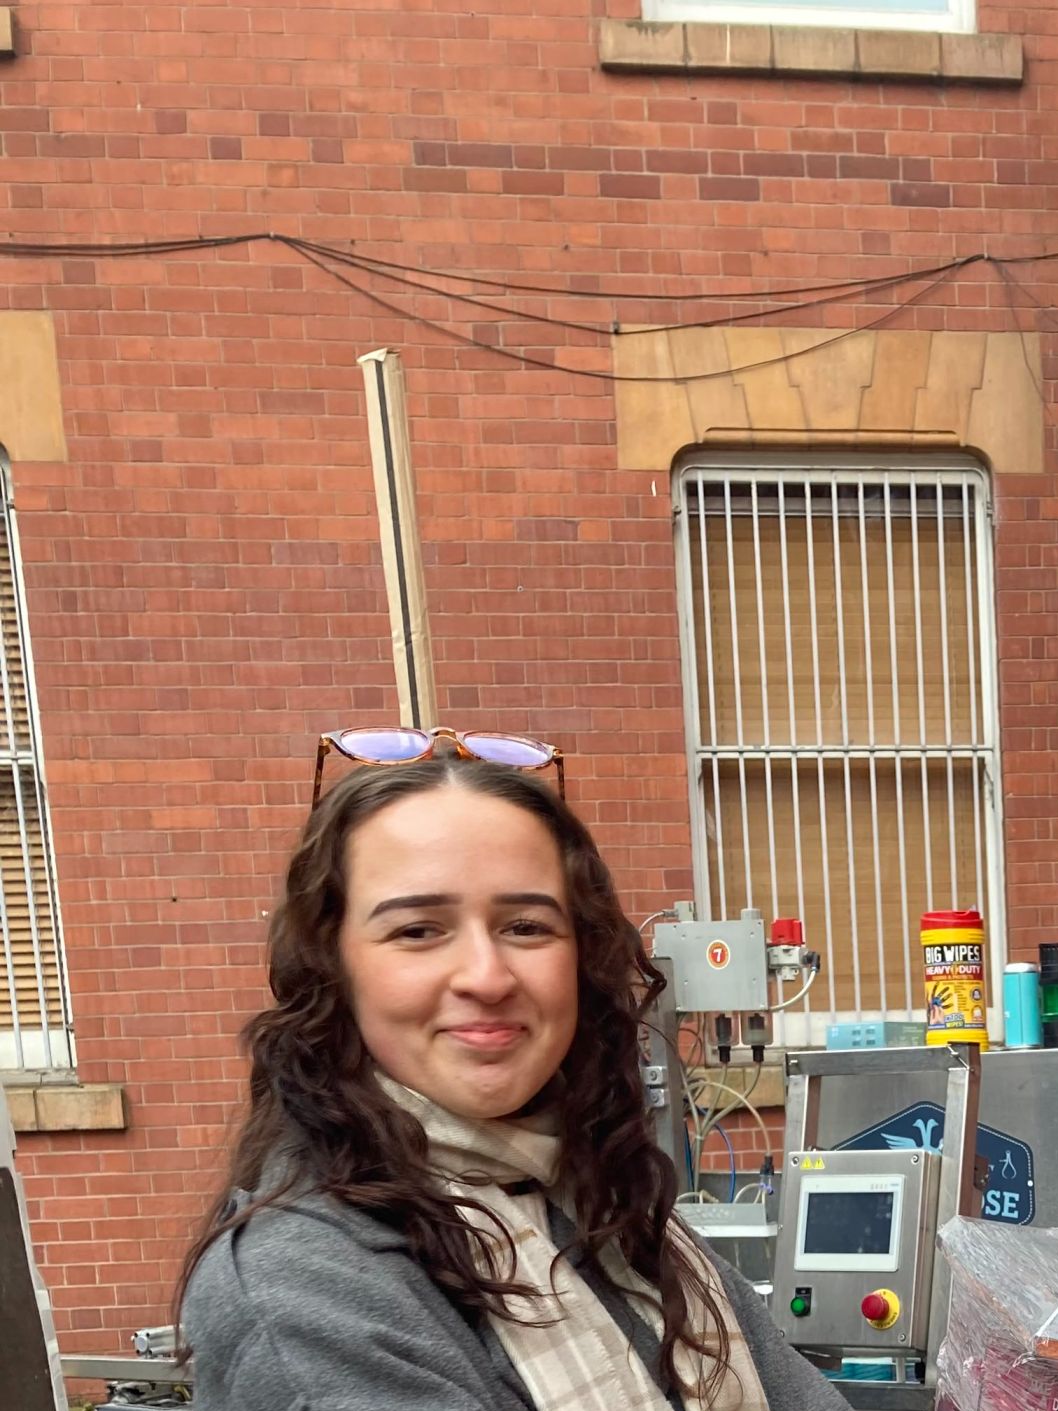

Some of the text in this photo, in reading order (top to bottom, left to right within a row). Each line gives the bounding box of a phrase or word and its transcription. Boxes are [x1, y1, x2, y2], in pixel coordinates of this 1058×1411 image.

[713, 949, 723, 963] 7
[925, 945, 980, 964] BIG WIPES
[925, 965, 981, 975] HEAVY DUTY
[982, 1190, 1019, 1218] SE
